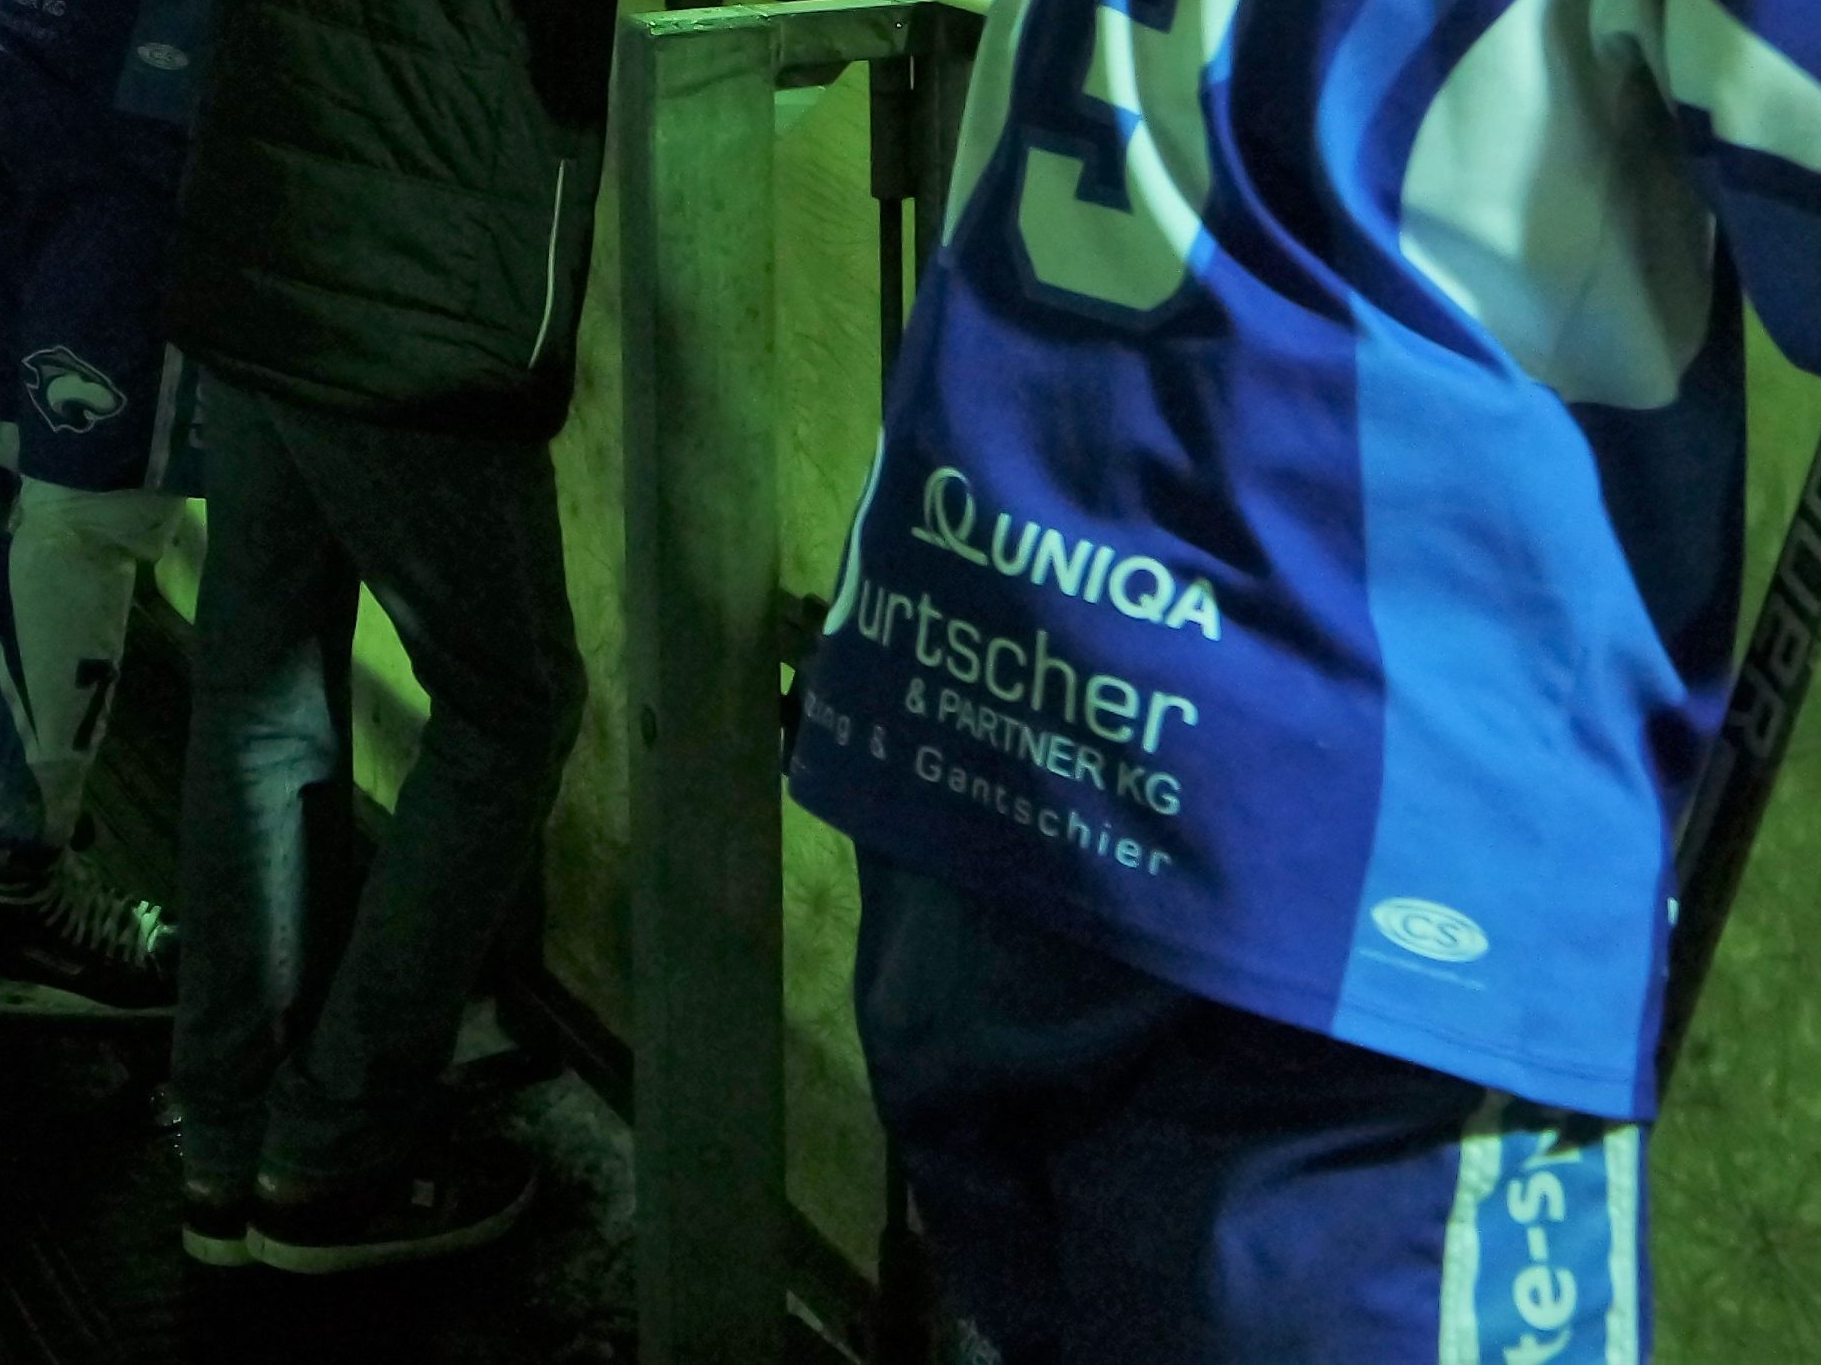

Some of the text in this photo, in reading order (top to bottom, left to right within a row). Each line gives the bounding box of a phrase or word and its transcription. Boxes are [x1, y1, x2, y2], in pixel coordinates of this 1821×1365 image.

[991, 511, 1222, 641] UNIQA
[857, 578, 1199, 755] urtscher
[905, 676, 1181, 816] & PARTNER KG
[914, 744, 1174, 878] Gantschier
